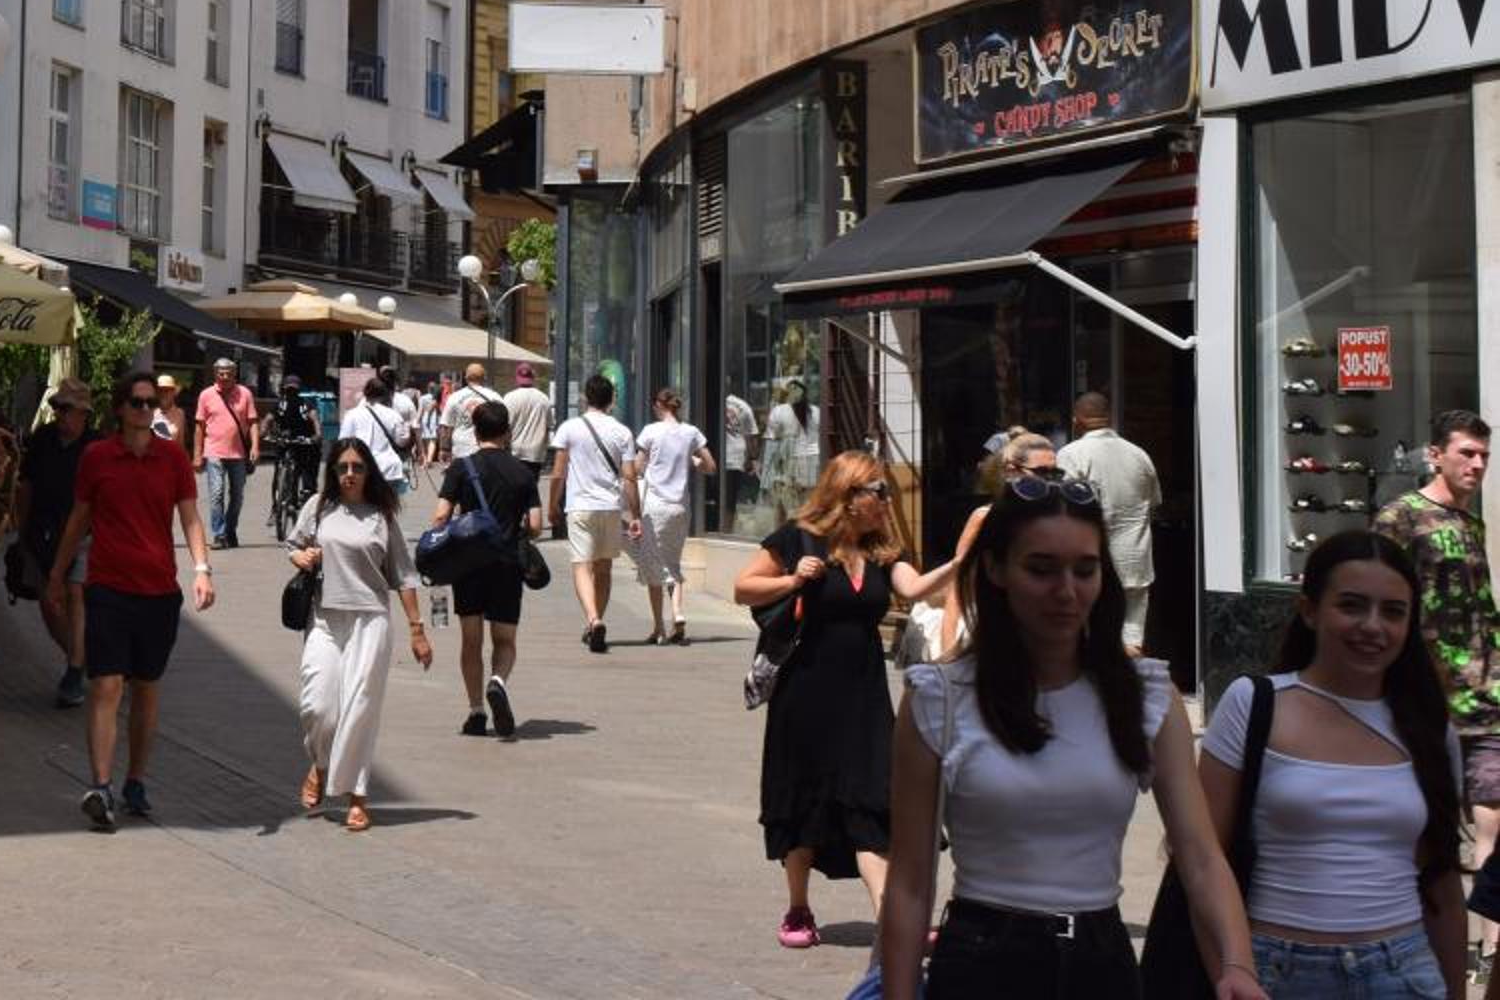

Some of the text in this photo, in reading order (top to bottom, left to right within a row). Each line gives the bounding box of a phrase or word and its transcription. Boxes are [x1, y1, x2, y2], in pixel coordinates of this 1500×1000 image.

[995, 92, 1097, 136] CANDY SHOP
[1341, 331, 1387, 345] POPUST
